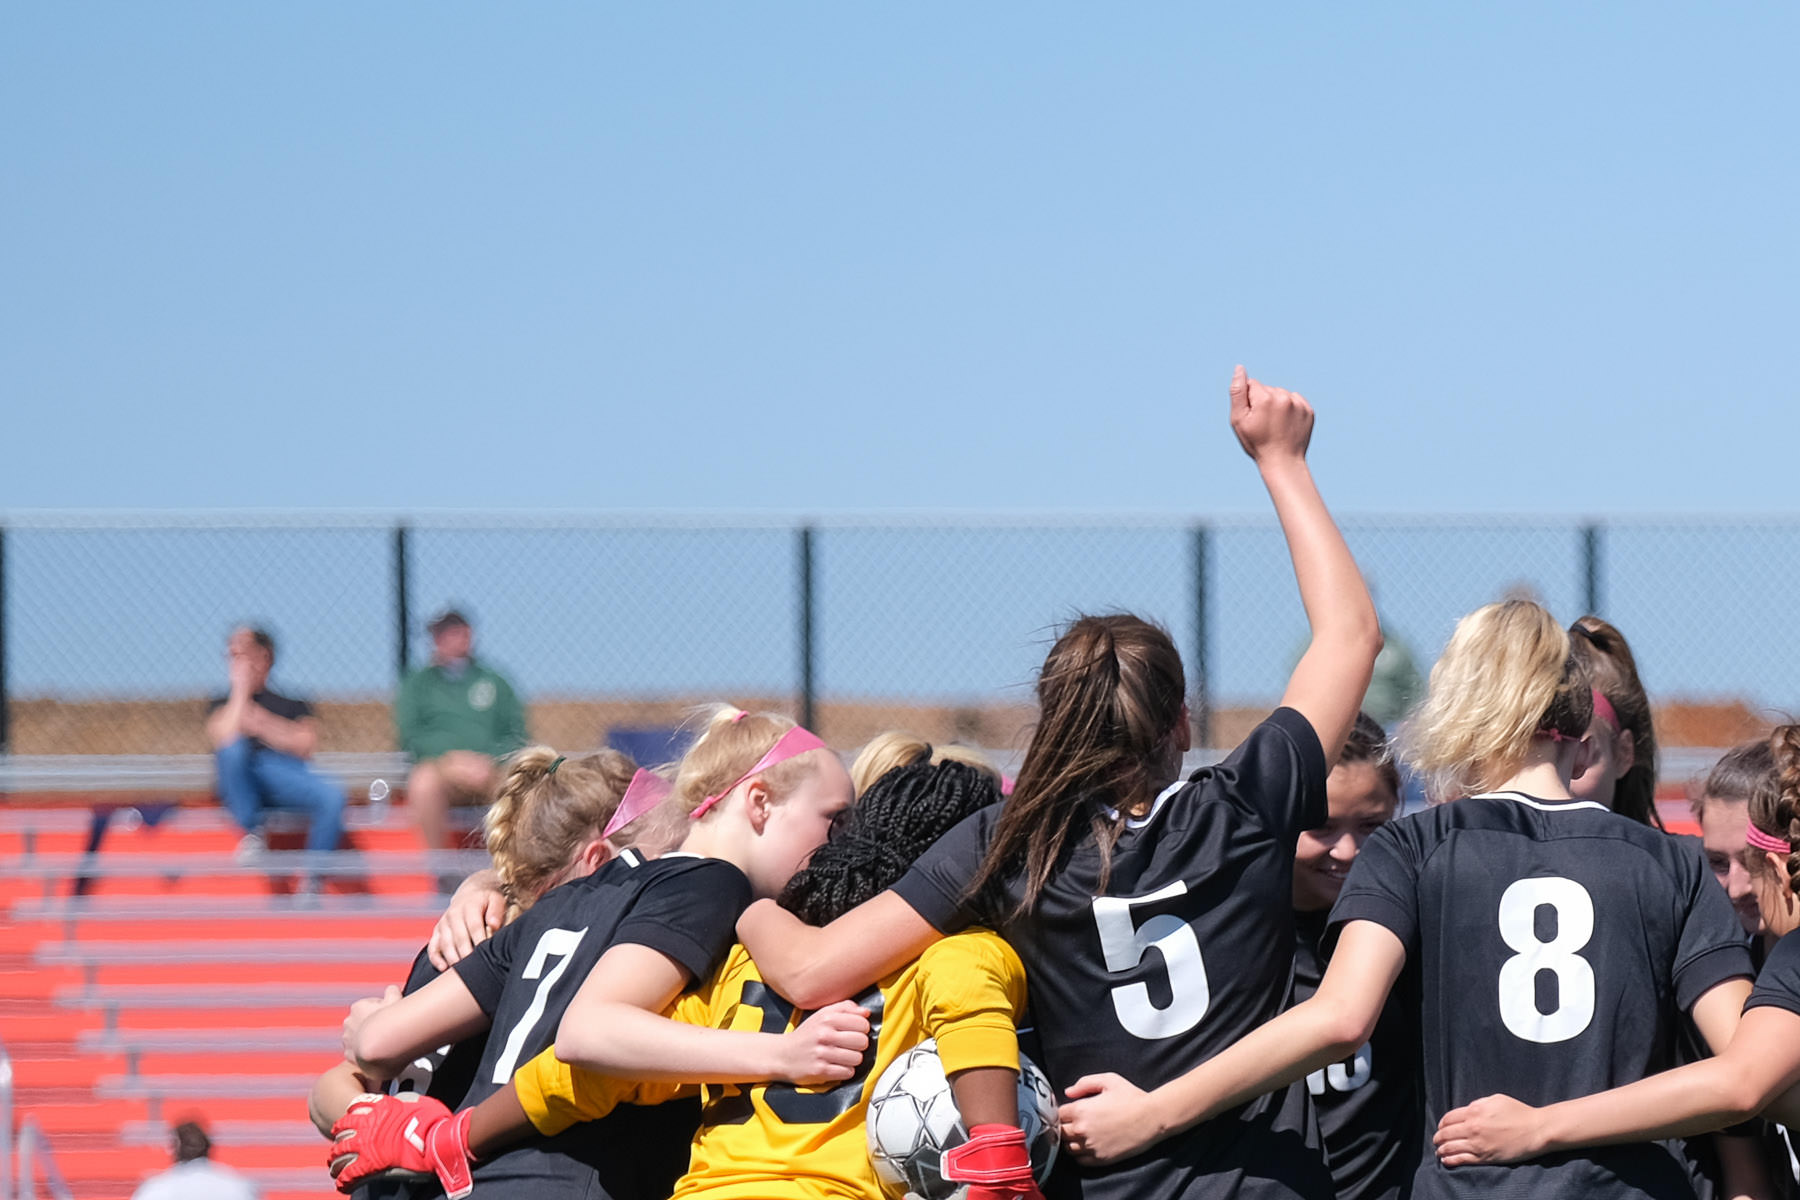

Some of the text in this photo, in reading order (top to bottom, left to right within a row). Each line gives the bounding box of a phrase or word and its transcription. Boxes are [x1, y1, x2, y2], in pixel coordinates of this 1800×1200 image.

[491, 926, 589, 1085] 7
[1091, 879, 1210, 1040] 5
[1498, 876, 1596, 1043] 8
